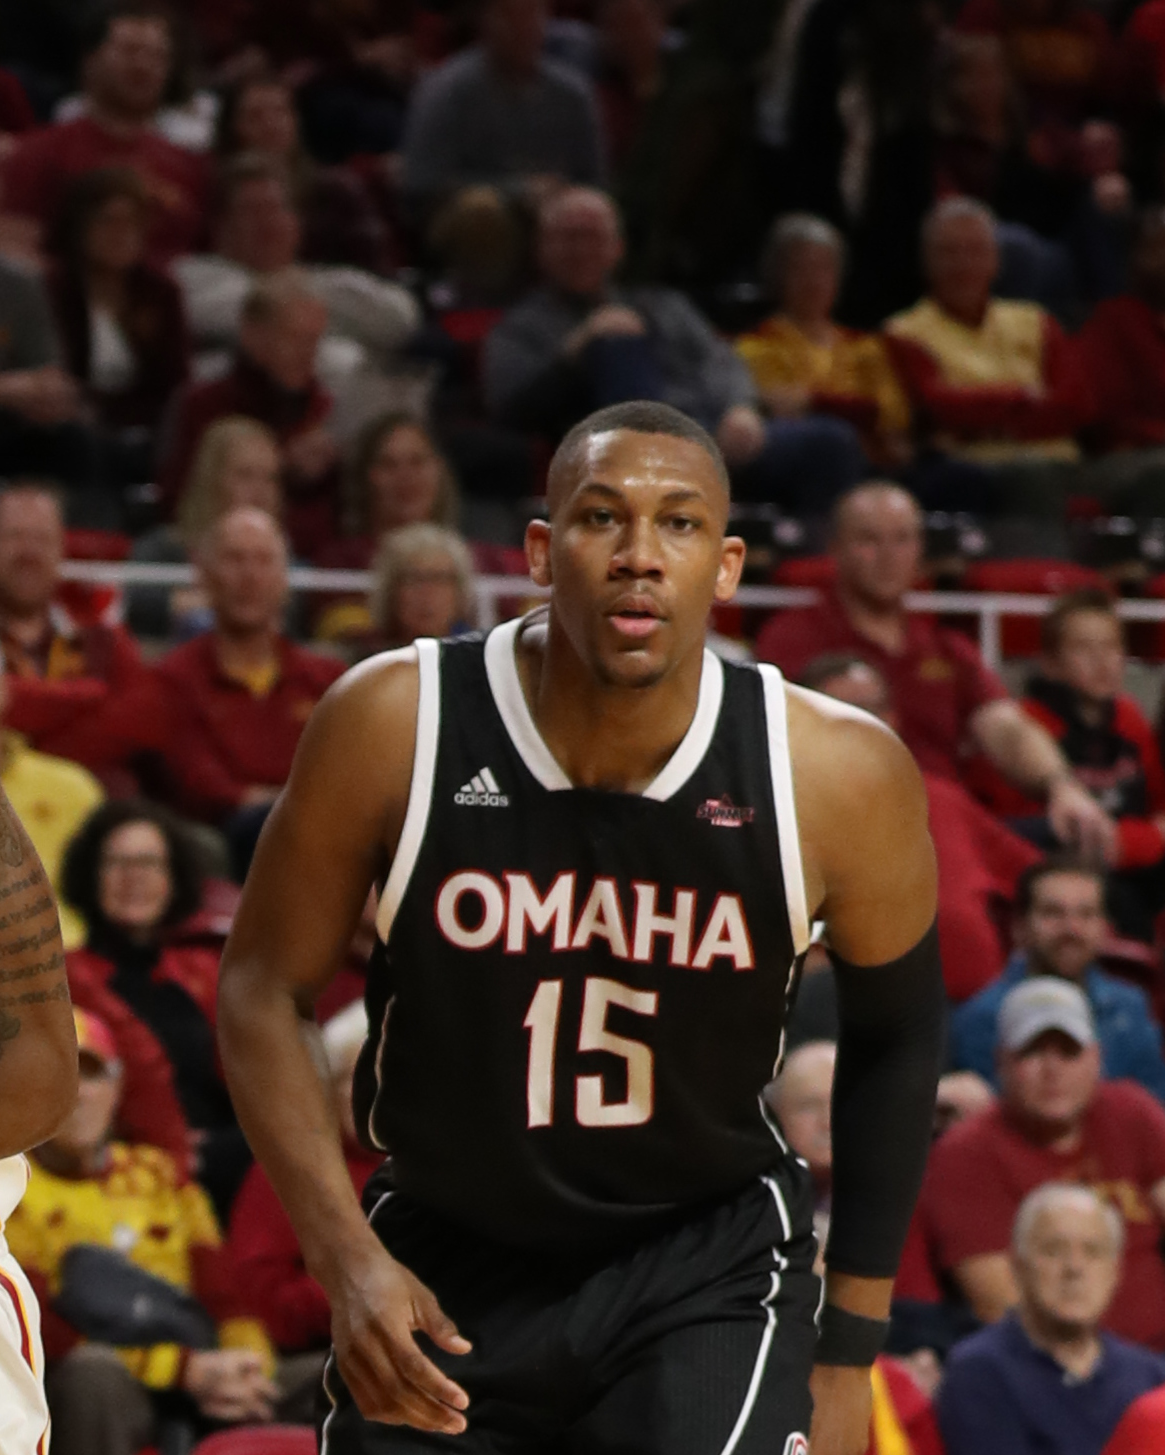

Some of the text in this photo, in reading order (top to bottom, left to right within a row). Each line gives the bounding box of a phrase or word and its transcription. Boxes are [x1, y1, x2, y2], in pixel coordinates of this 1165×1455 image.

[453, 791, 509, 807] adidas
[434, 868, 756, 973] OMAHA
[522, 975, 660, 1130] 15
